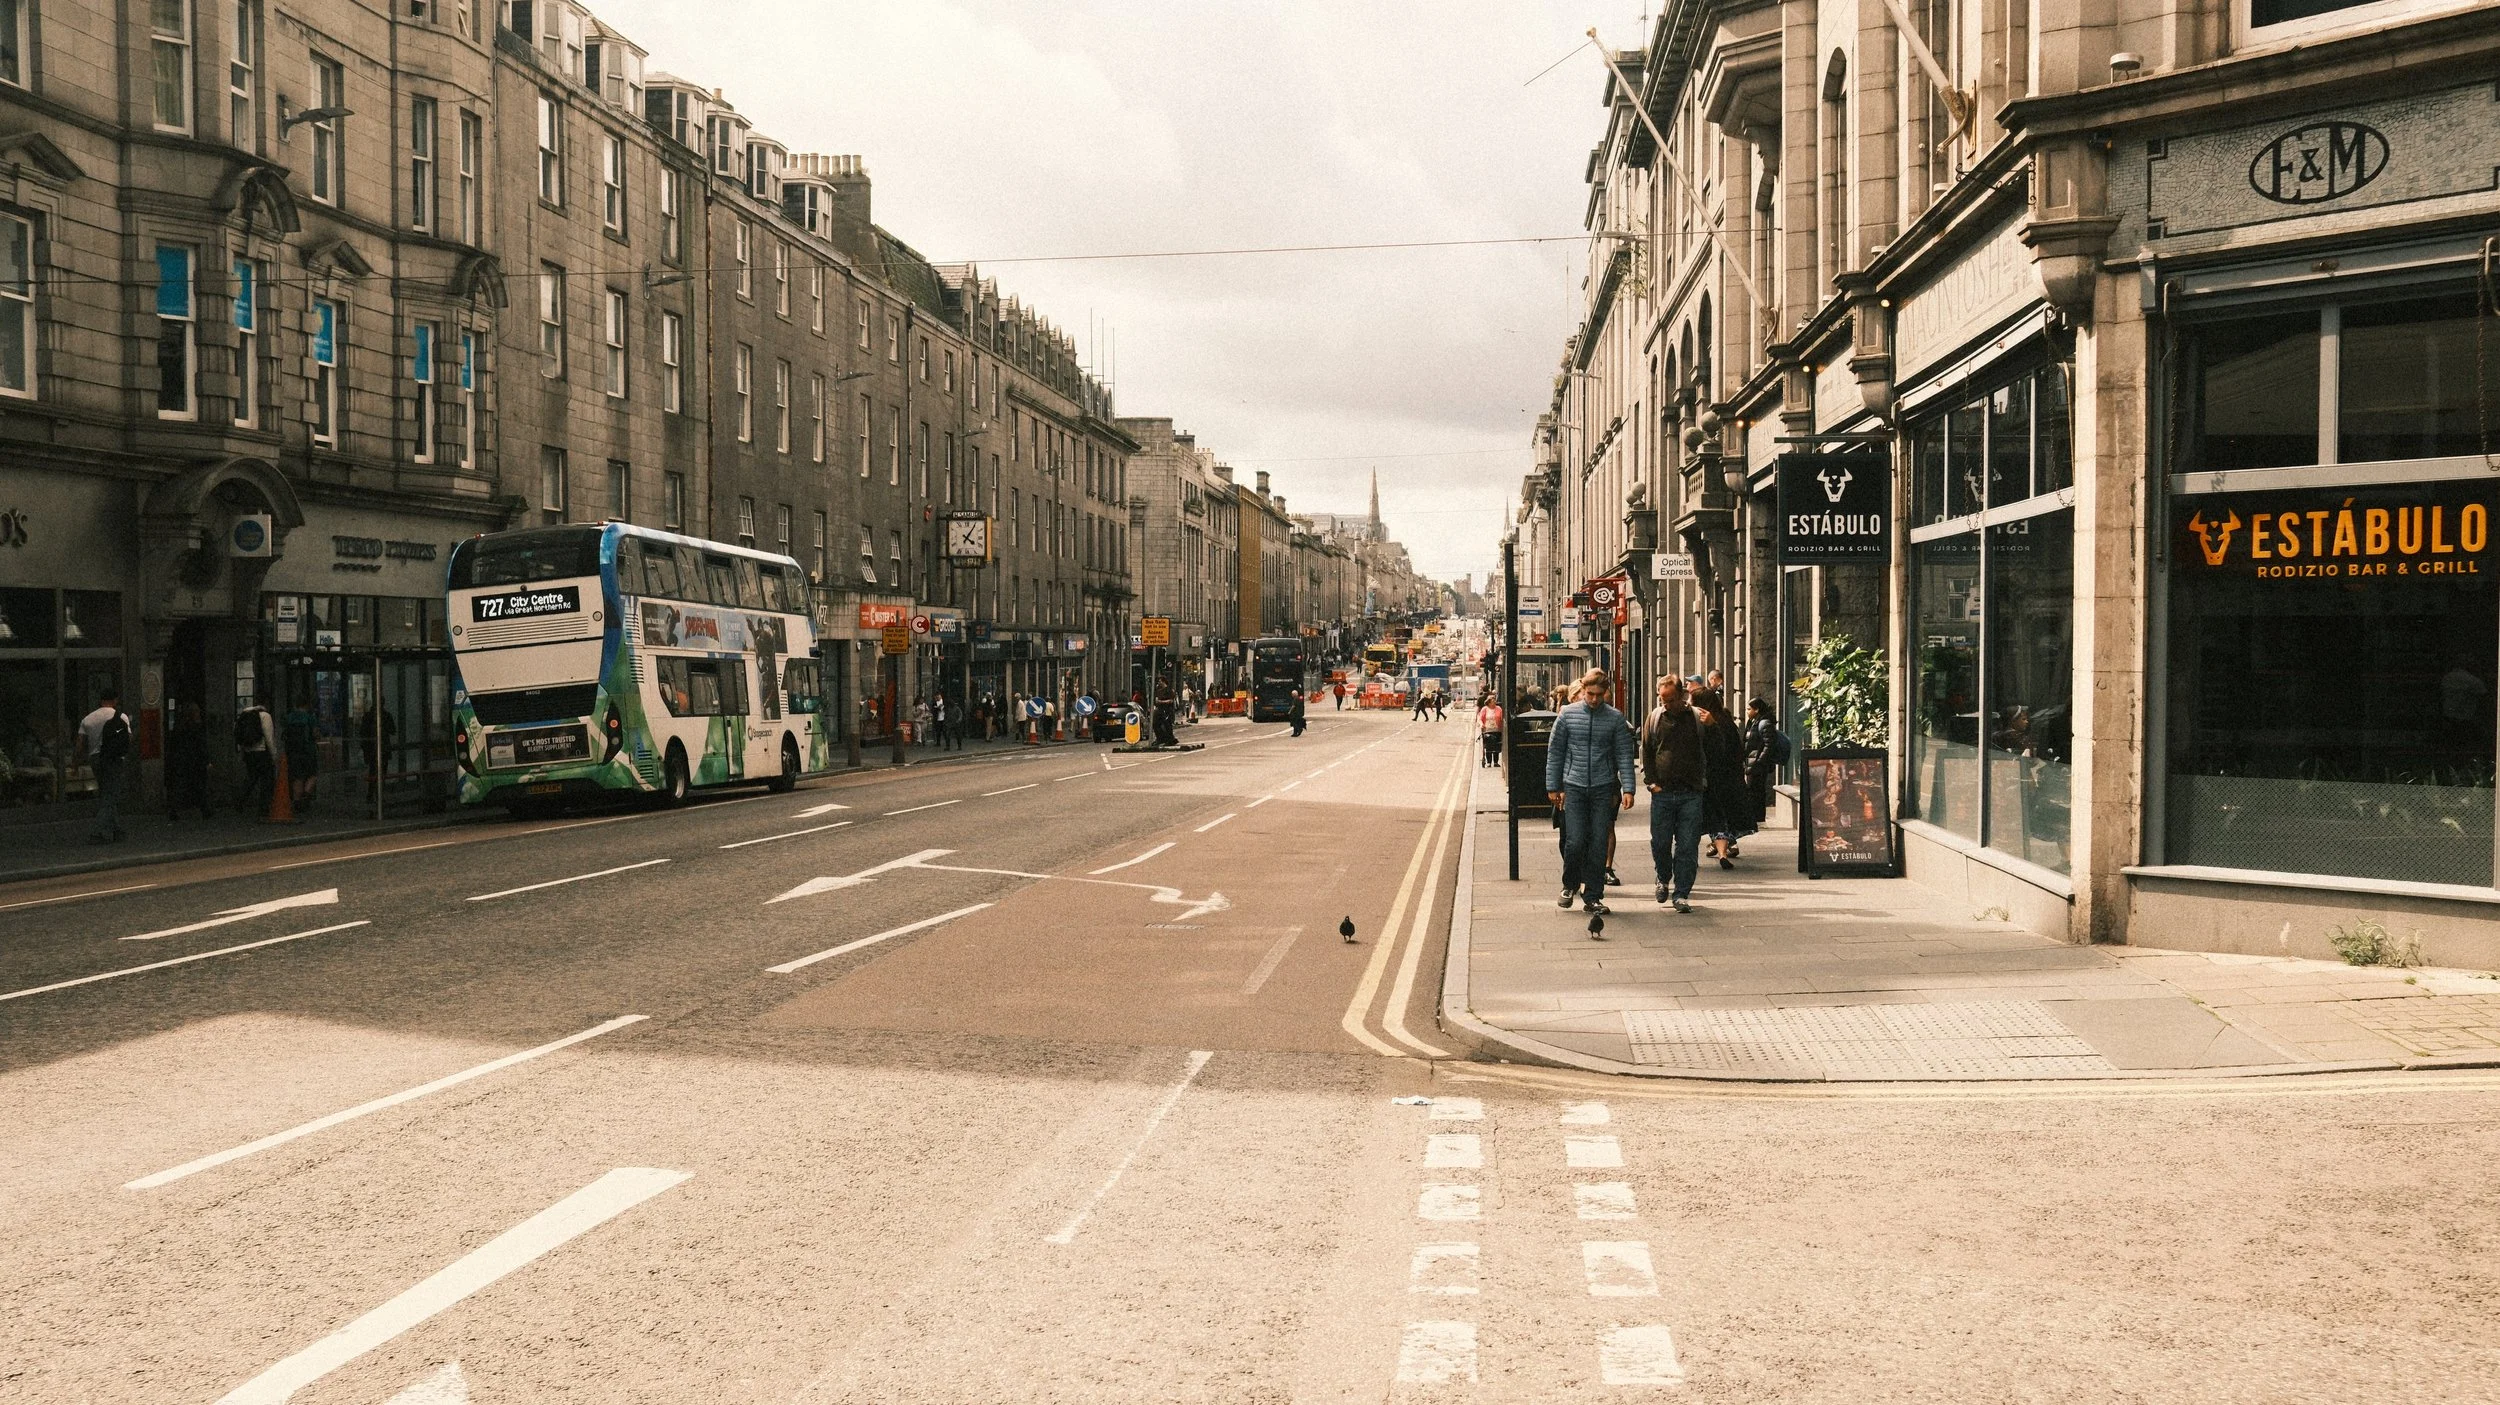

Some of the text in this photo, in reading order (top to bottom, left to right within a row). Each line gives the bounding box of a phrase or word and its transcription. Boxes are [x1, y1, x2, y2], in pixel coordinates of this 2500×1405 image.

[1788, 510, 1881, 536] ESTÁBULO
[2251, 497, 2487, 558] ESTÁBULO
[1662, 558, 1690, 568] Optical
[2257, 560, 2479, 578] RODIZIO BAR & GRILL
[1660, 568, 1692, 578] Express
[480, 593, 564, 618] 727 City Centre
[536, 738, 551, 746] MOST
[552, 735, 576, 744] TRUSTED
